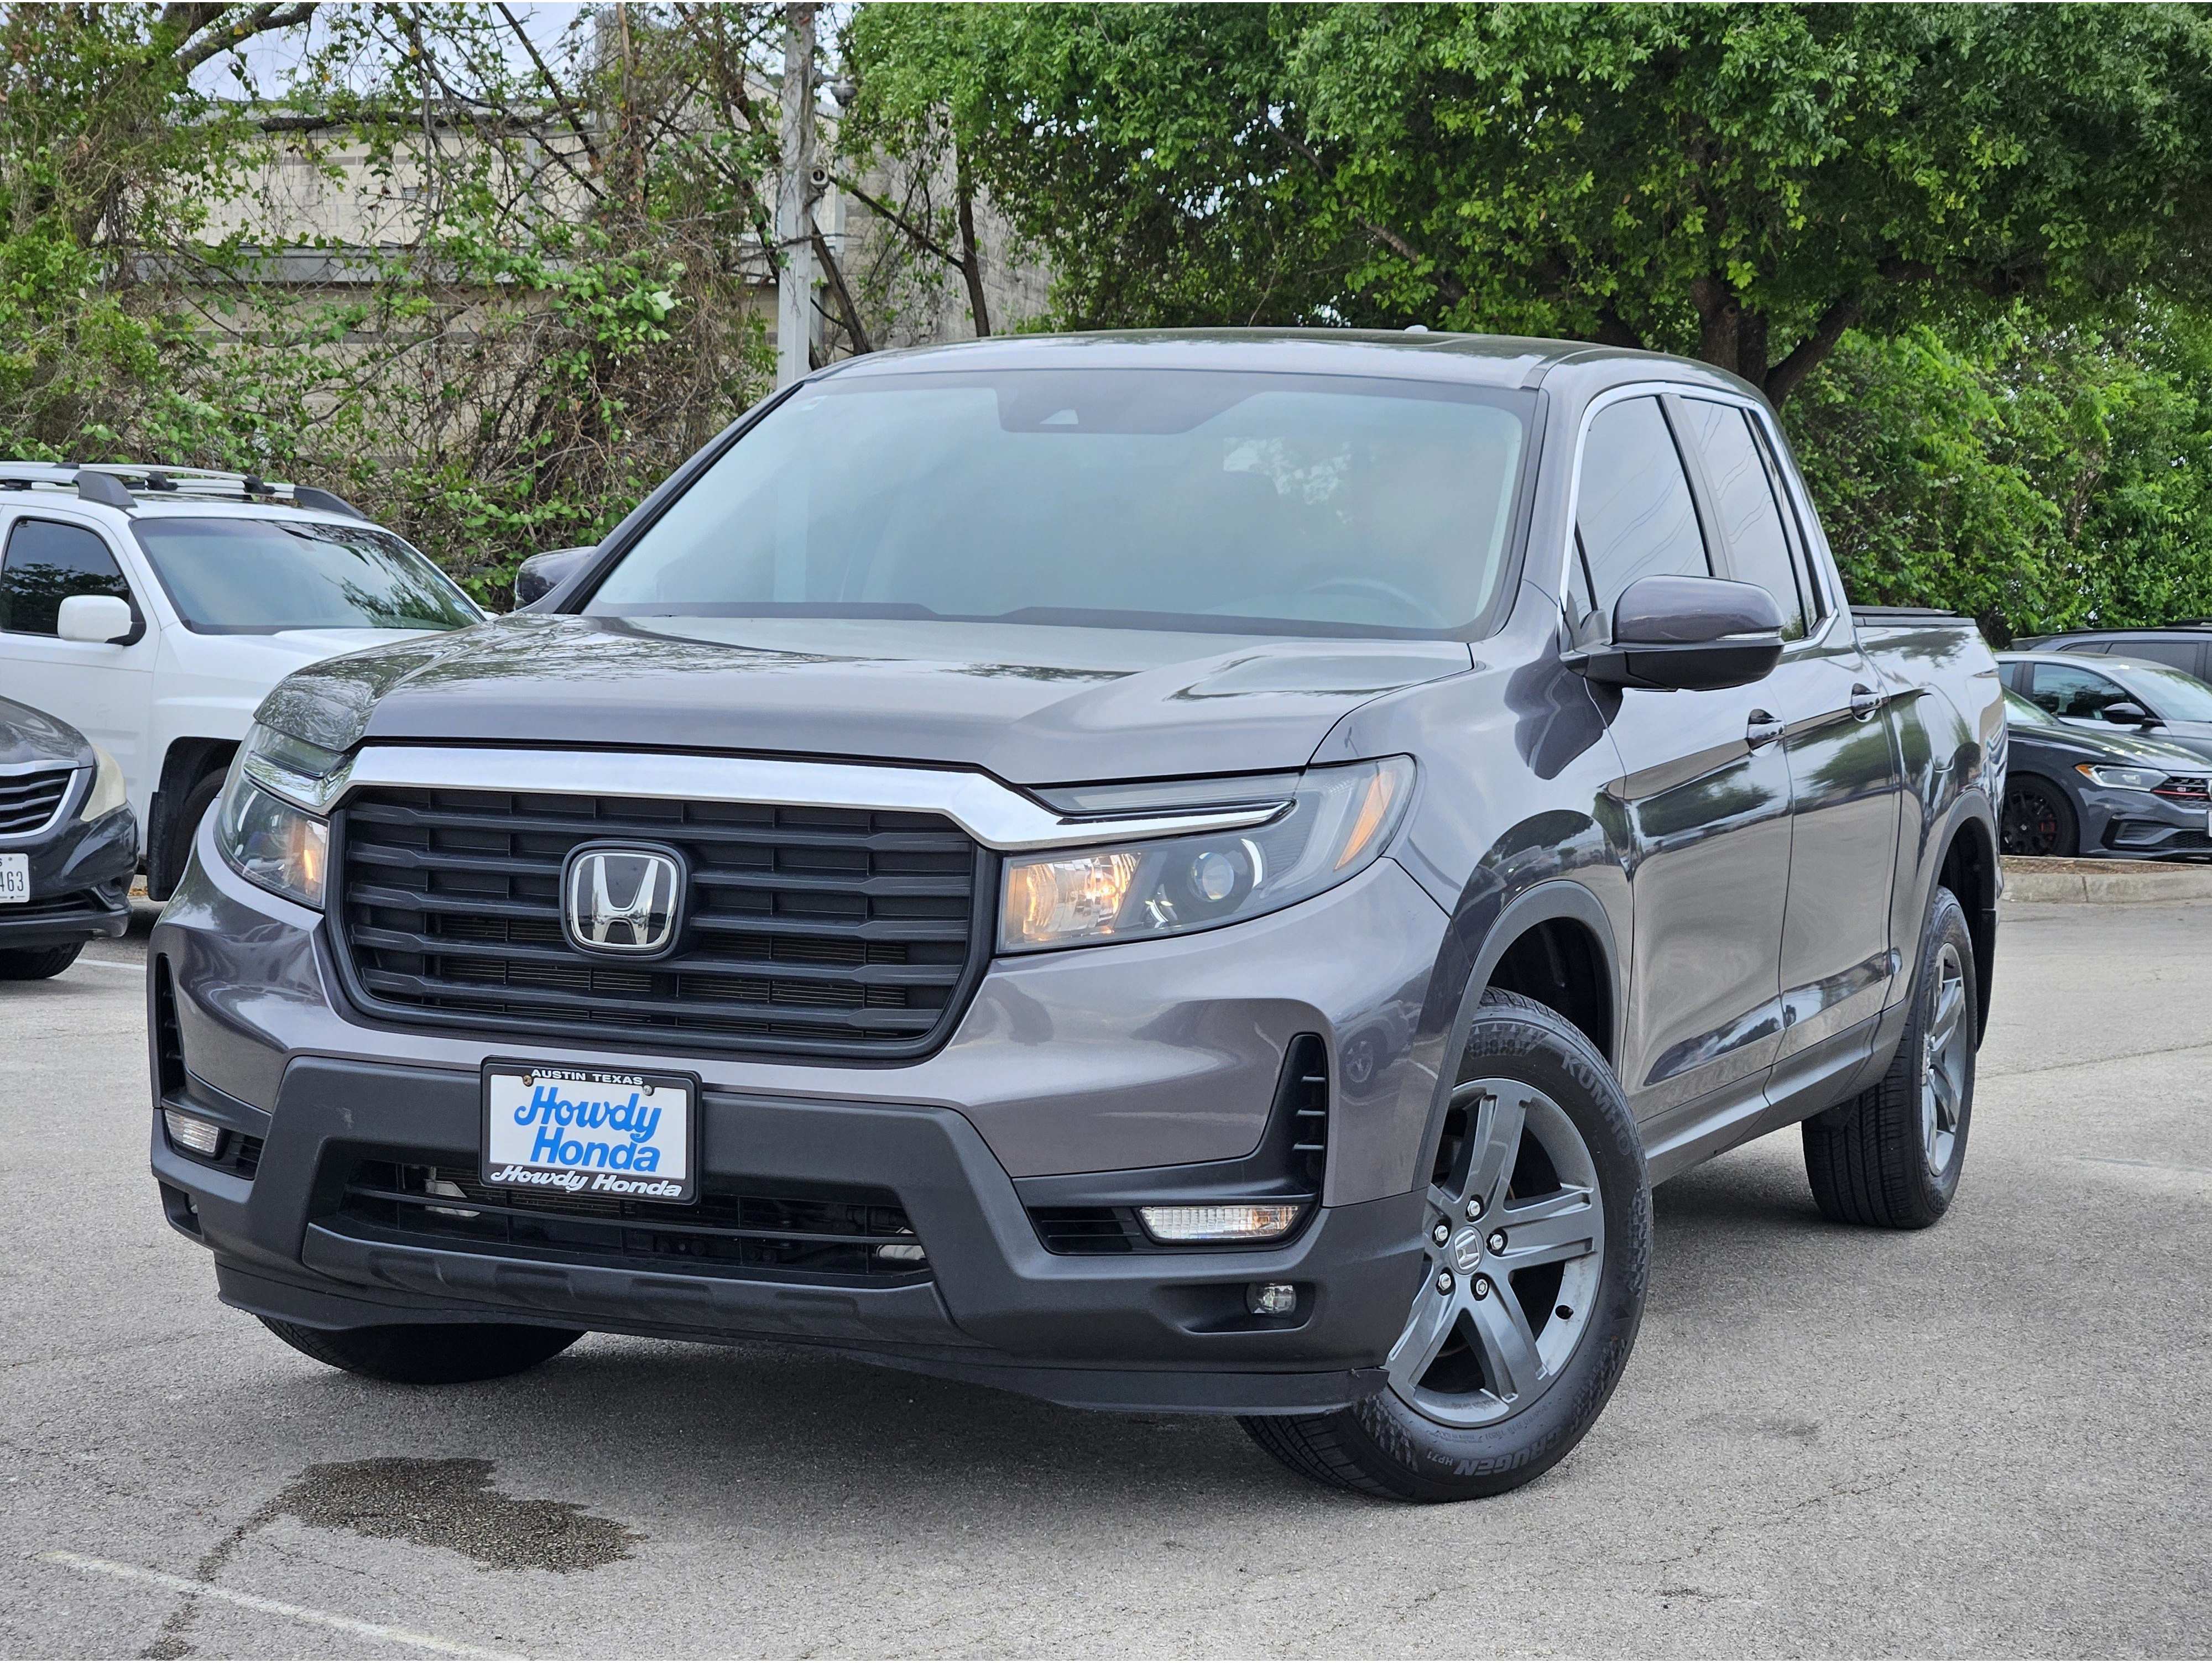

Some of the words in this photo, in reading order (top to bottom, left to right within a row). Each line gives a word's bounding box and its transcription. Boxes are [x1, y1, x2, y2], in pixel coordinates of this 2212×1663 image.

[531, 1070, 586, 1081] AUSTIN
[593, 1074, 644, 1085] TEXAS
[514, 1086, 662, 1143] Howdy
[1561, 1050, 1632, 1155] KUMHO
[530, 1126, 660, 1172] Honda
[491, 1165, 589, 1193] Howdy
[592, 1174, 682, 1197] Honda
[1427, 1451, 1453, 1466] HP71
